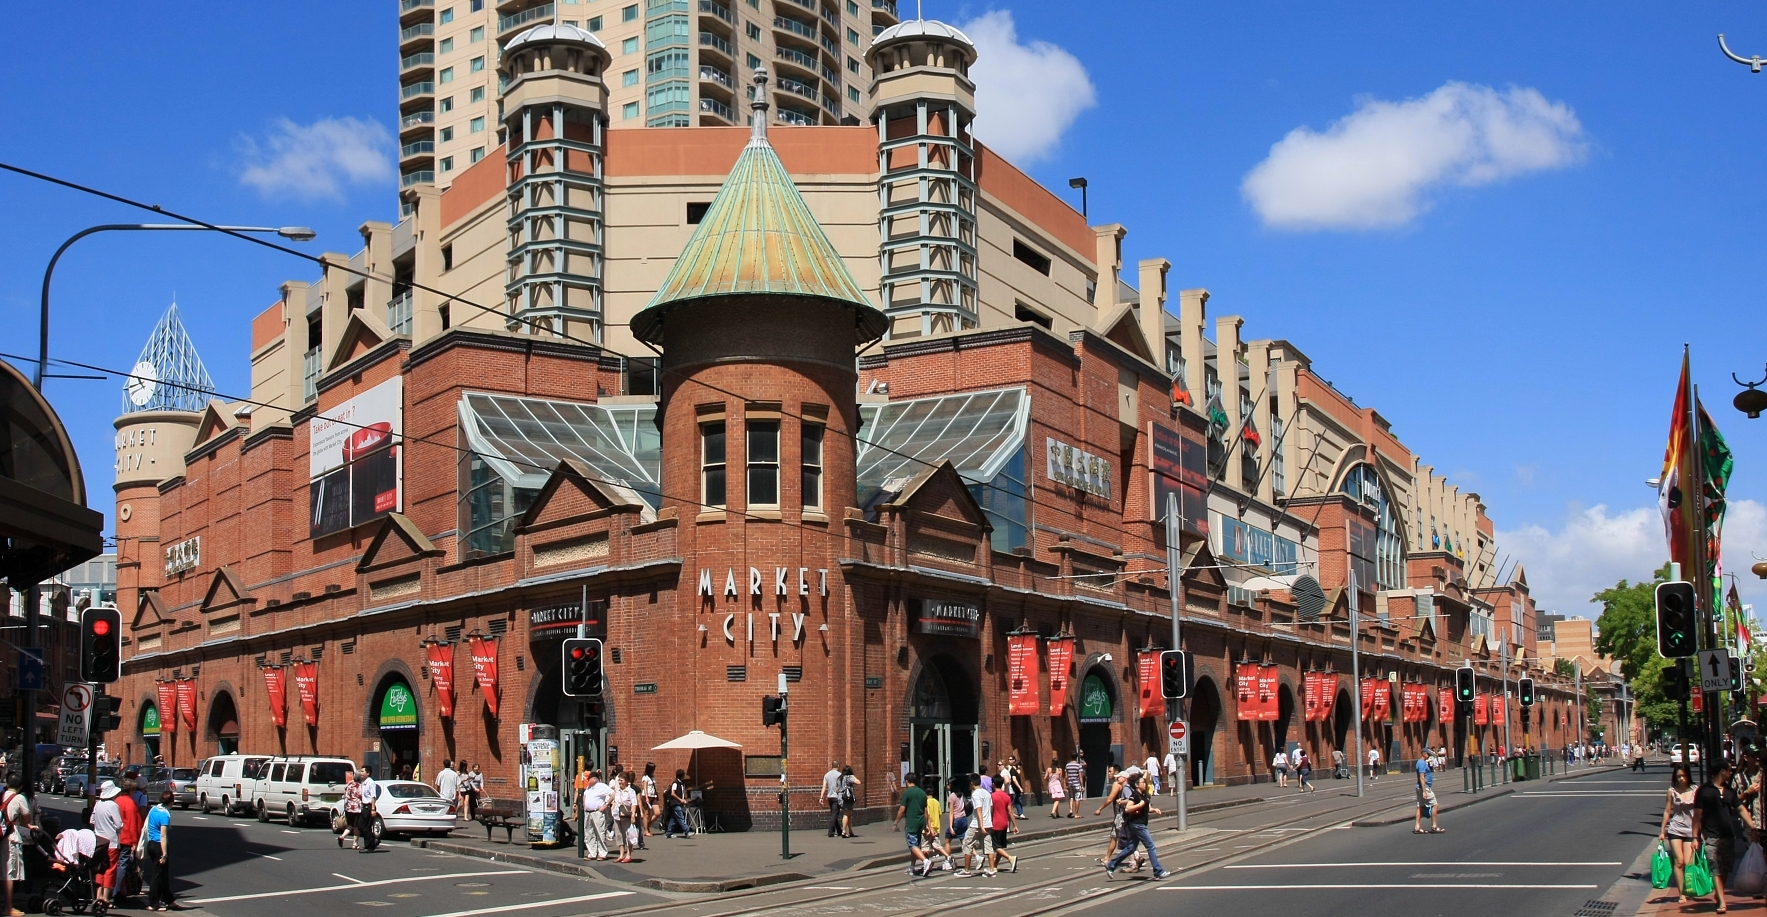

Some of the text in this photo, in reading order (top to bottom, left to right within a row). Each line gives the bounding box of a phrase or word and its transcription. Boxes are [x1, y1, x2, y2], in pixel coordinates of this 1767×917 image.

[697, 566, 829, 597] MARKET
[532, 606, 580, 624] MARKET CITY
[936, 604, 966, 619] MARKET
[723, 612, 805, 641] CITY
[1704, 677, 1729, 688] ONLY
[65, 714, 83, 725] NO
[62, 726, 84, 734] LEFT
[60, 734, 84, 743] TURN
